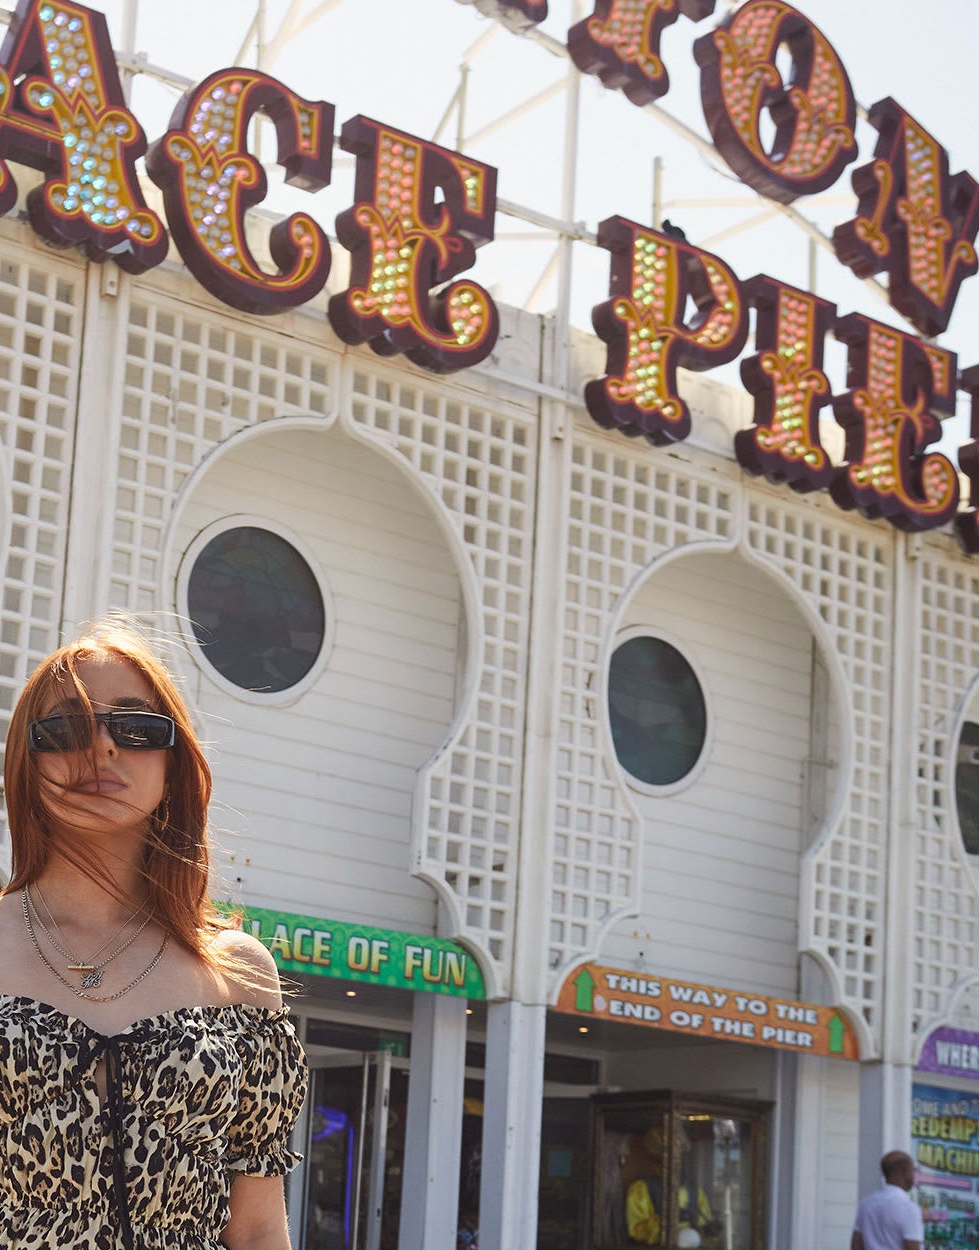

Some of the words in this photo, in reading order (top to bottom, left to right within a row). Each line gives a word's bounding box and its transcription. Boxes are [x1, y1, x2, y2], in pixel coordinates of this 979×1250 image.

[584, 214, 979, 553] PIE
[346, 935, 391, 975] OF
[404, 944, 468, 988] FUN
[604, 972, 662, 998] THIS
[669, 984, 728, 1009] WAY
[734, 995, 768, 1016] TO
[775, 1002, 818, 1026] THE
[608, 999, 662, 1022] END
[669, 1010, 704, 1029] OF
[710, 1016, 756, 1039] THE
[761, 1025, 813, 1048] PIER
